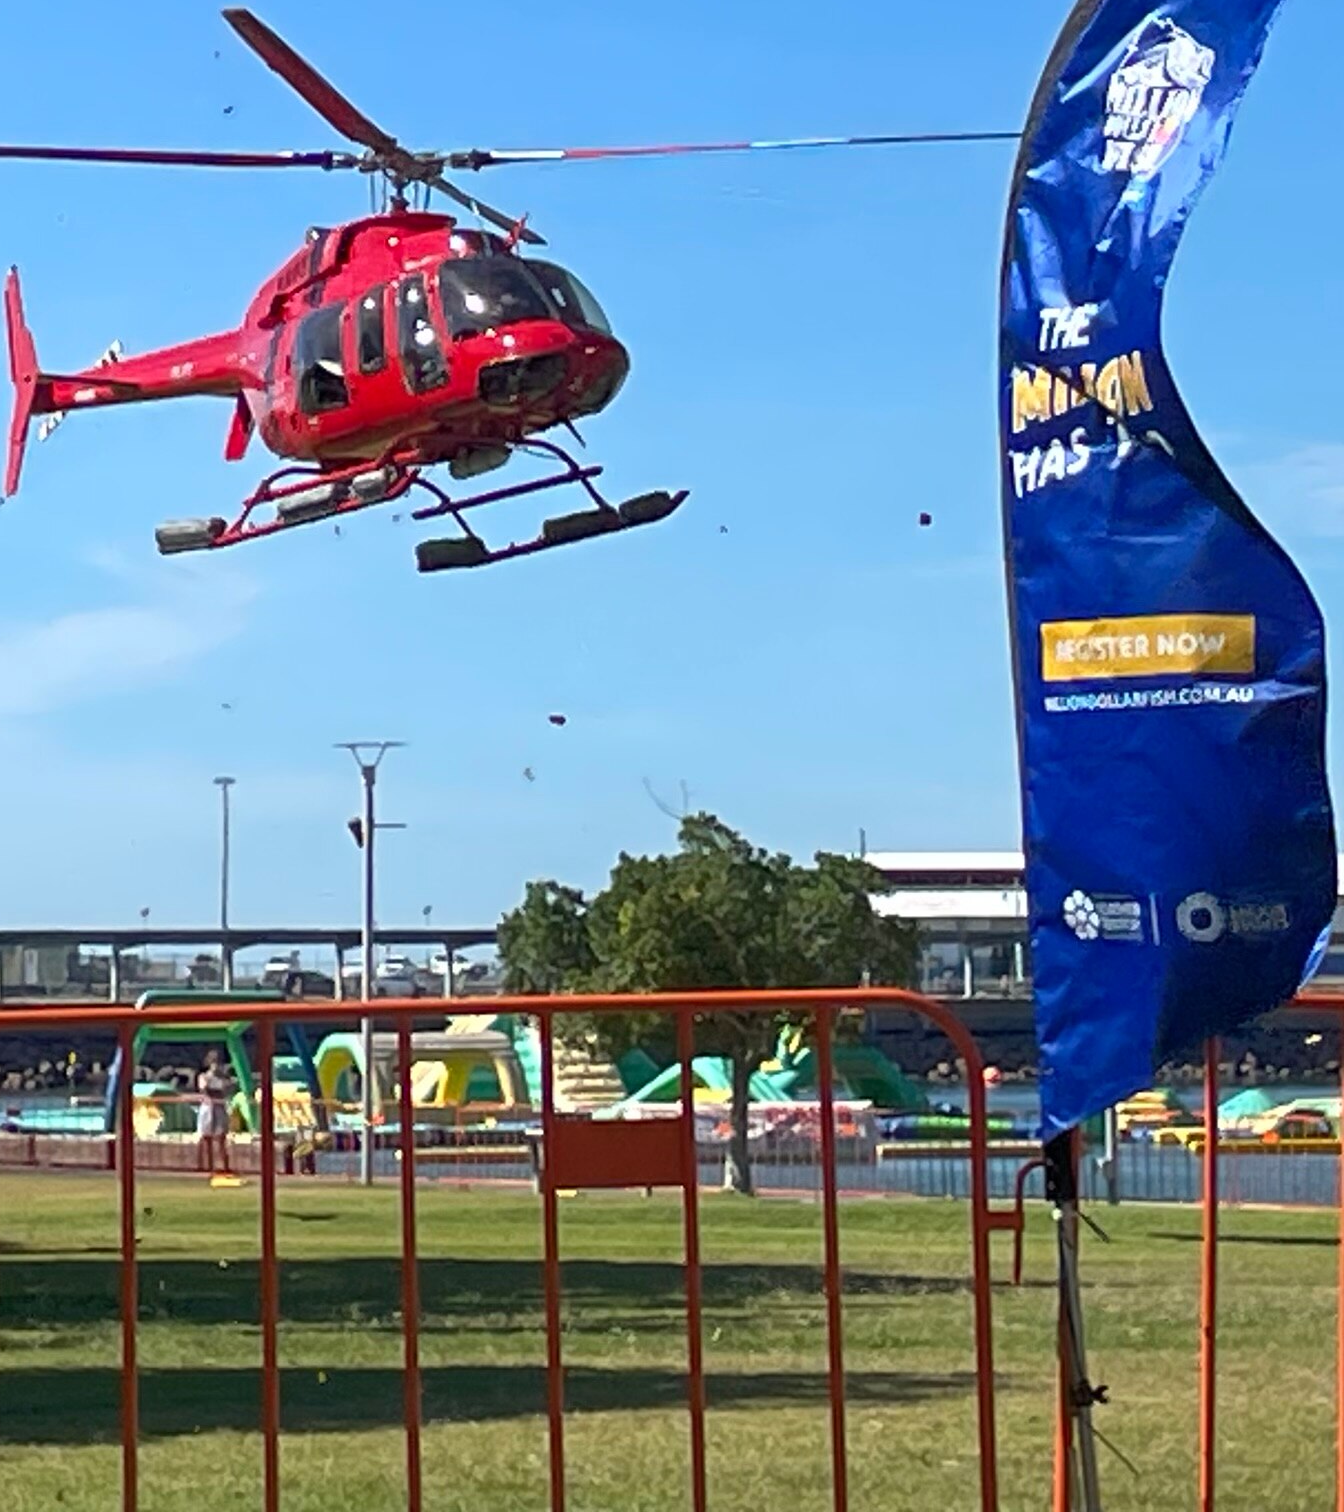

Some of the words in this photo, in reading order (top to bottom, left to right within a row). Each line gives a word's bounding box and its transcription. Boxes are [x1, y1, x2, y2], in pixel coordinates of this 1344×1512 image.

[1039, 303, 1099, 352] THE
[1008, 427, 1091, 499] HAS
[1157, 631, 1227, 658] NOW
